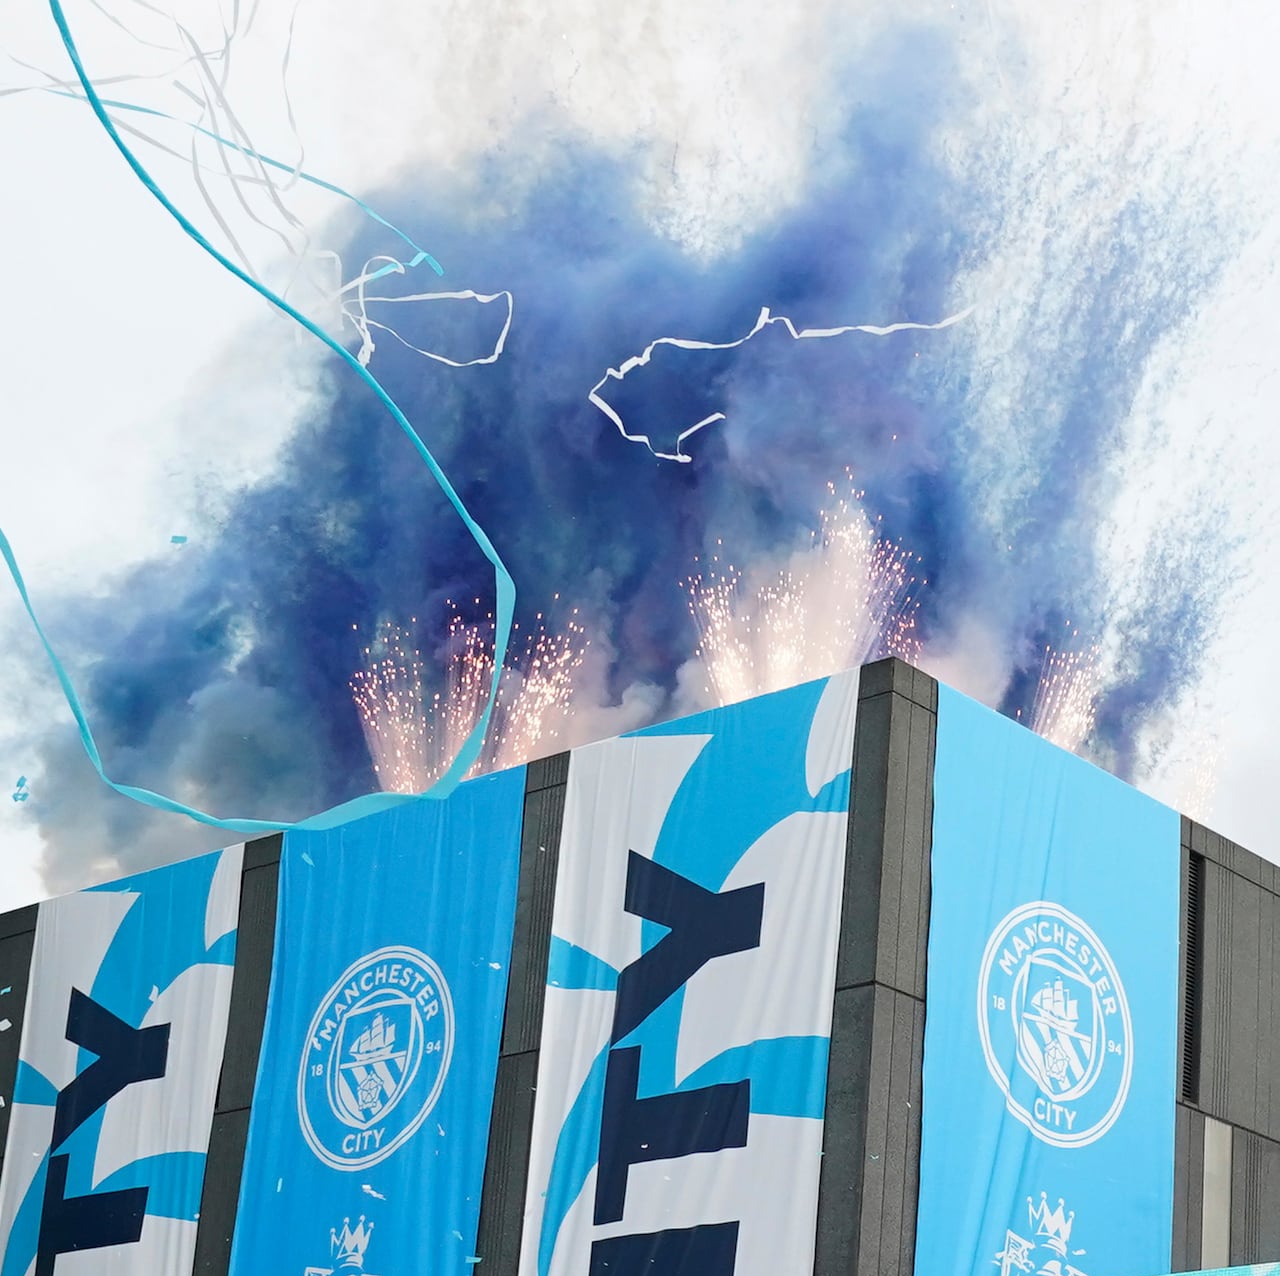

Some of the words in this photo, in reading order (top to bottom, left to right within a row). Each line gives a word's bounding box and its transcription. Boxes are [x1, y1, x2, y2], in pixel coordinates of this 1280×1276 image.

[998, 920, 1118, 1016] MANCHESTER
[320, 963, 440, 1042] MANCHESTER
[425, 1039, 442, 1055] 94
[1107, 1039, 1123, 1056] 94
[311, 1063, 324, 1078] 18
[1033, 1097, 1078, 1130] CITY
[341, 1127, 386, 1155] CITY
